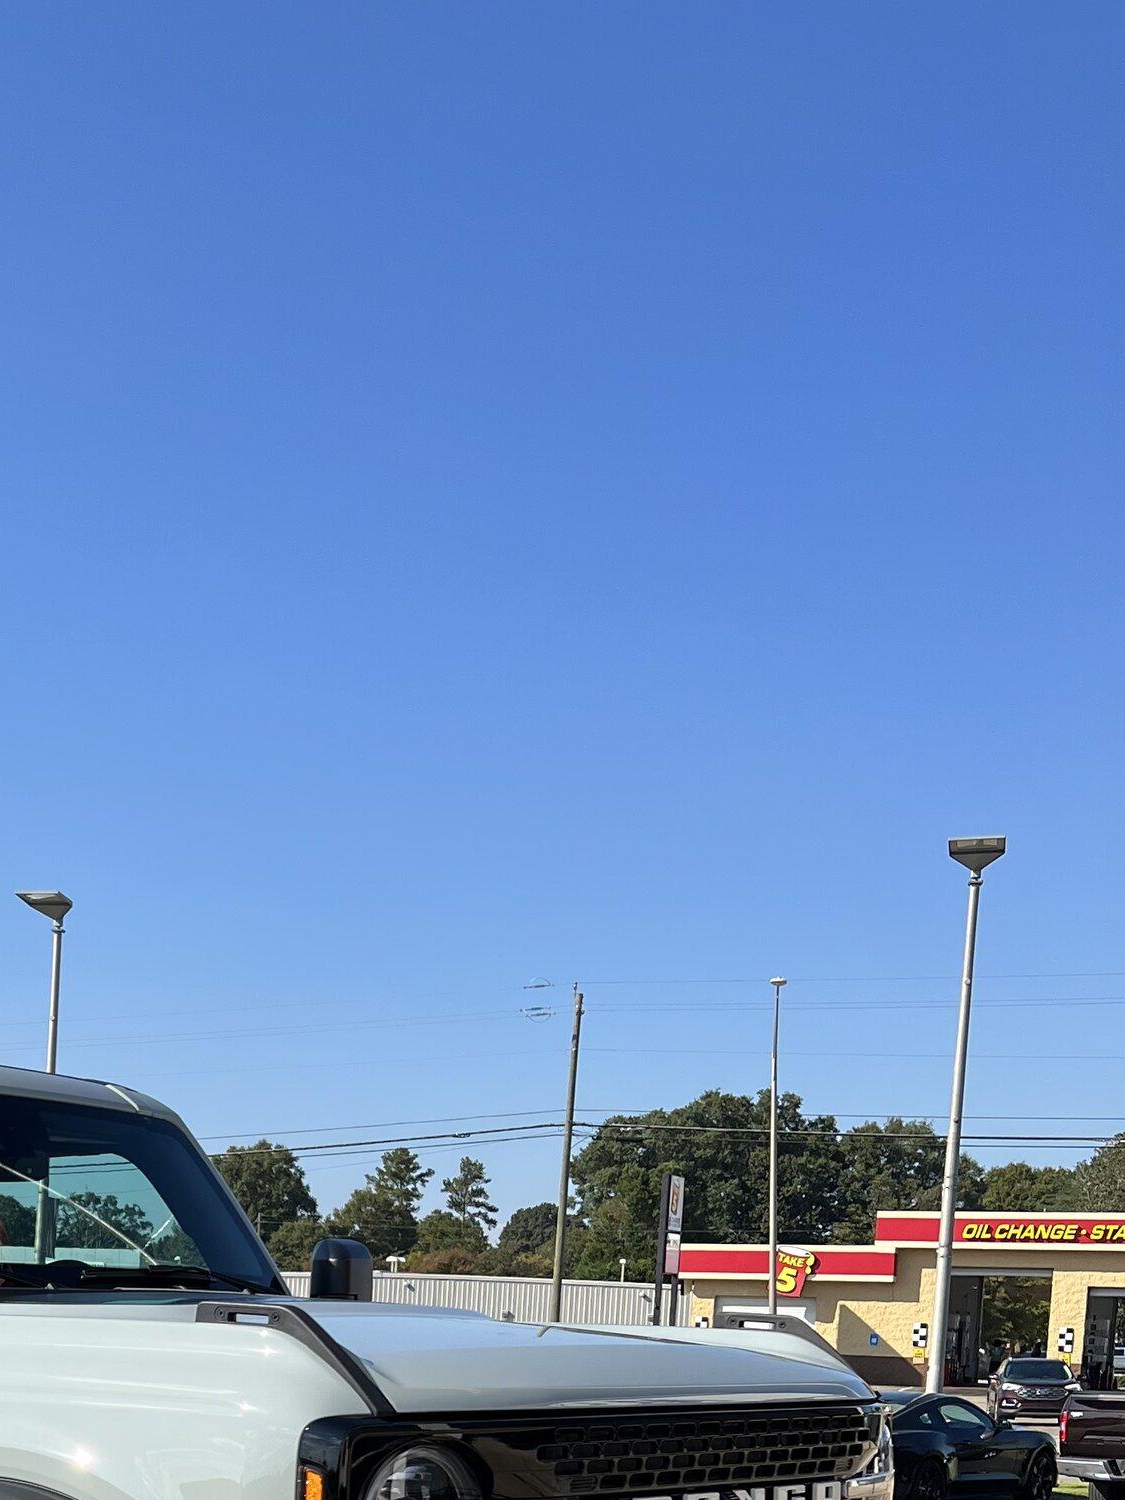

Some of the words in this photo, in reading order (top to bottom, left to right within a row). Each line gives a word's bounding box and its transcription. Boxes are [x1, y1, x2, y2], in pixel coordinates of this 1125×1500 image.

[961, 1223, 992, 1240] OIL
[994, 1223, 1079, 1241] CHANGE
[778, 1252, 806, 1268] TAKE
[776, 1266, 798, 1293] 5
